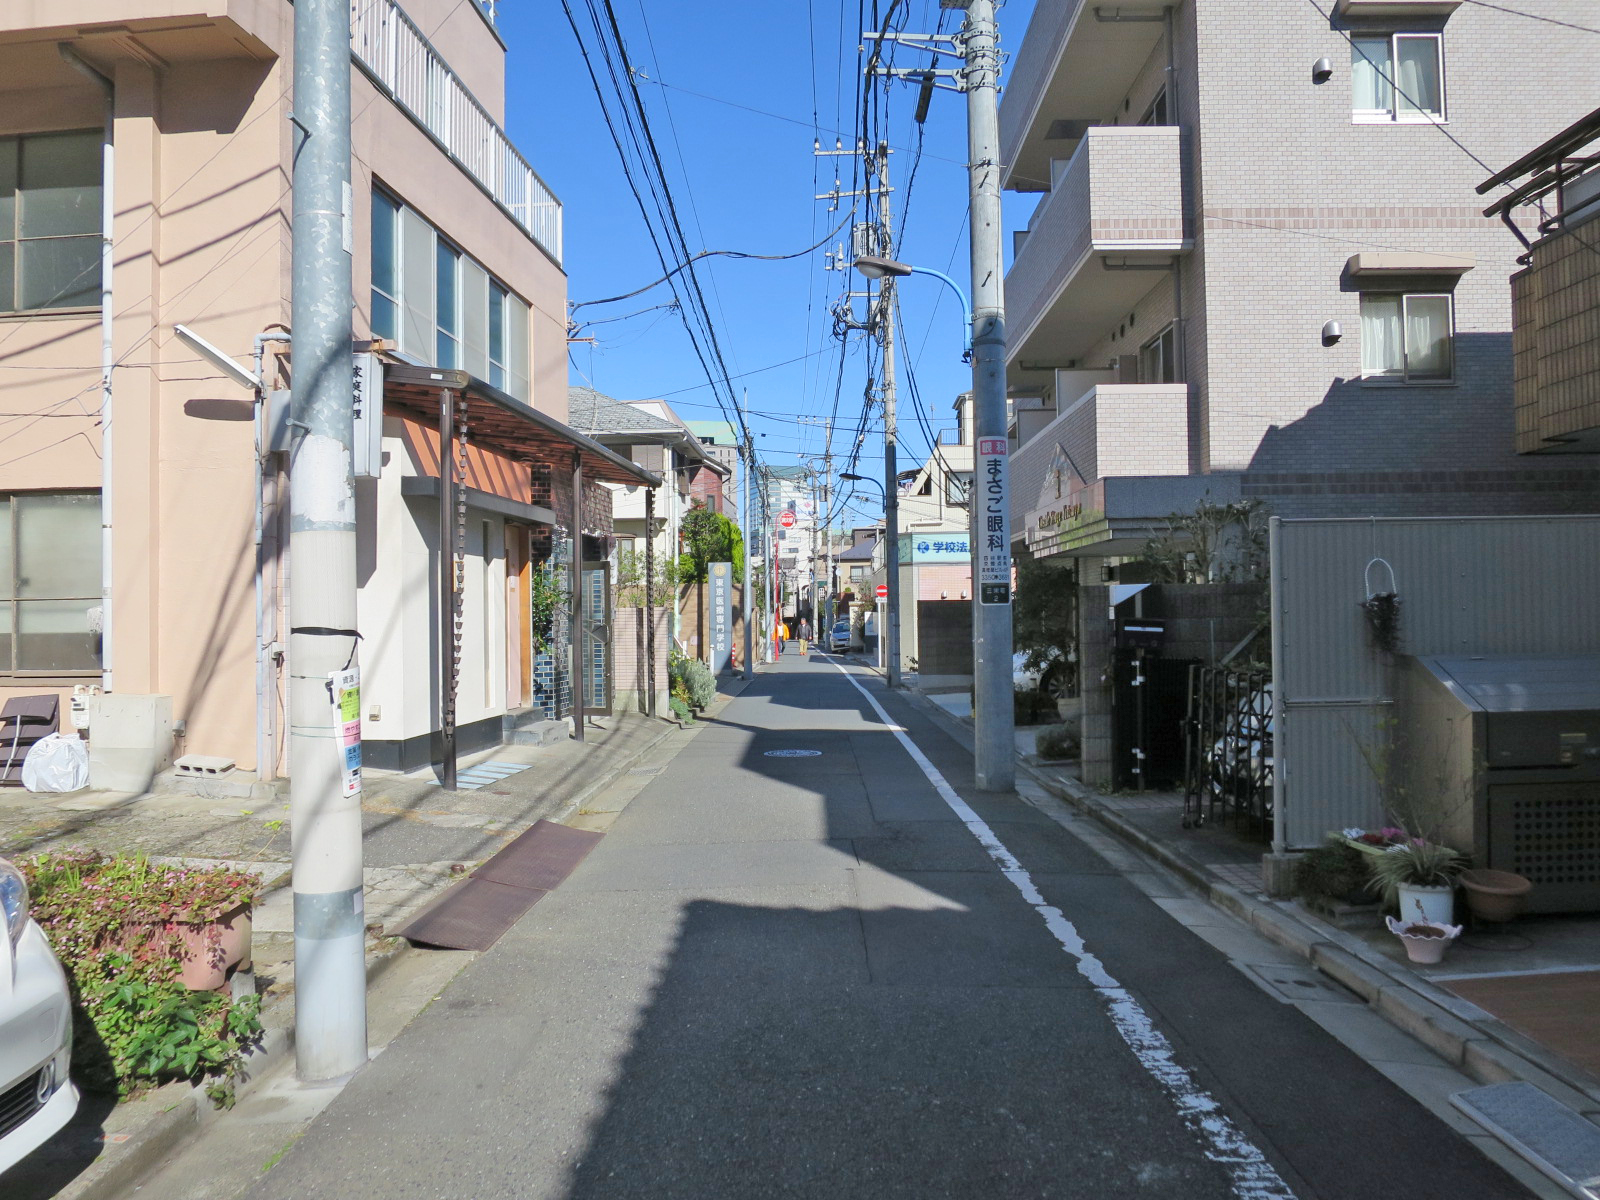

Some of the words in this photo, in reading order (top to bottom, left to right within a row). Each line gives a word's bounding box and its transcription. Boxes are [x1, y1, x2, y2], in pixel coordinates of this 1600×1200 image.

[982, 441, 1005, 454] 眼科
[986, 458, 1004, 552] まさご眼科
[932, 541, 971, 553] 学校法
[715, 578, 725, 651] 東京医療専門学校
